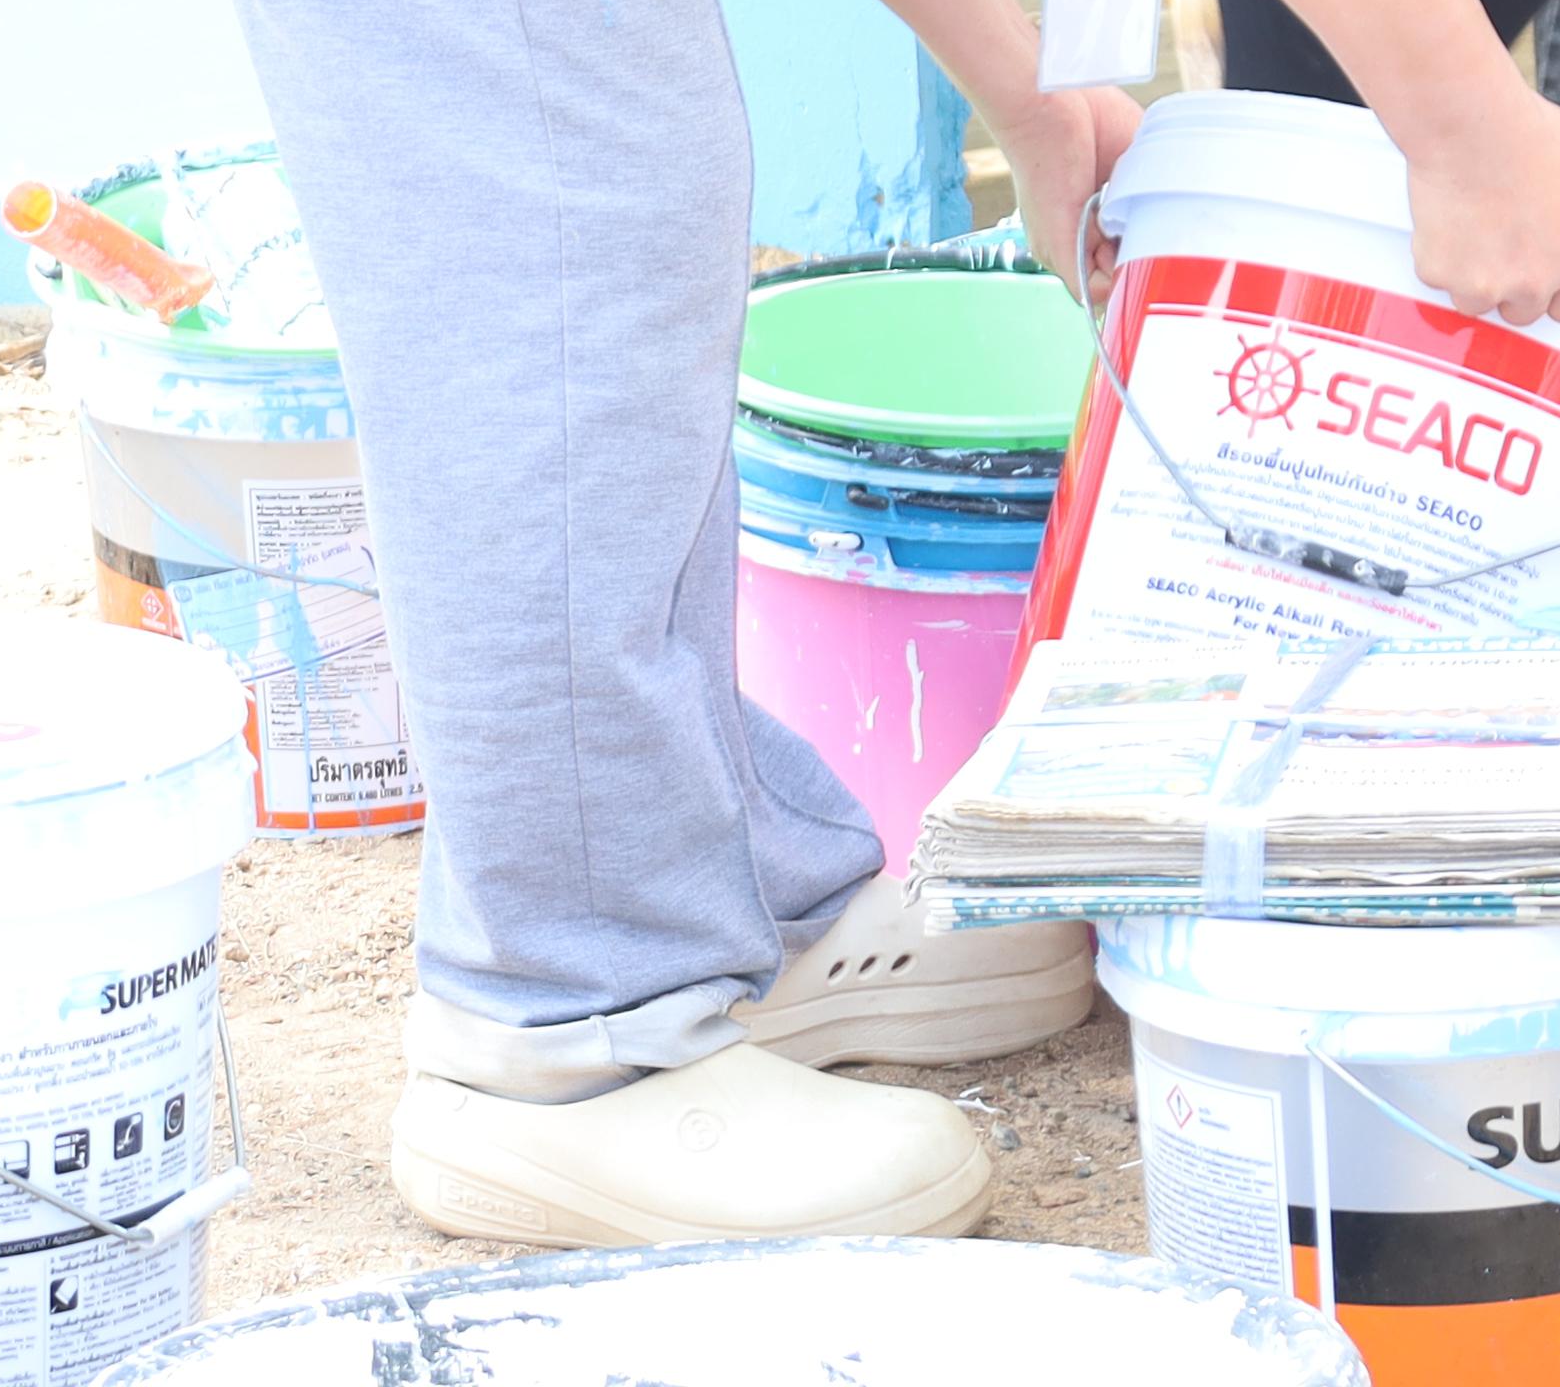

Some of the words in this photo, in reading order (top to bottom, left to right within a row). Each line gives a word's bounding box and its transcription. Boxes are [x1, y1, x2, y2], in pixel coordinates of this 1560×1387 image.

[1317, 370, 1544, 497] SEACO
[1216, 442, 1408, 507] สีรองพื้นปูนใหม่กันด่าง
[1415, 494, 1484, 532] SEACO
[1145, 575, 1200, 598] SEACO
[1205, 587, 1266, 613] Acrylic
[1272, 602, 1325, 629] Alkali
[1233, 614, 1260, 631] For
[1265, 621, 1302, 642] New
[309, 748, 408, 789] ปริมาตรสุทธิ
[100, 963, 178, 1015] SUPER
